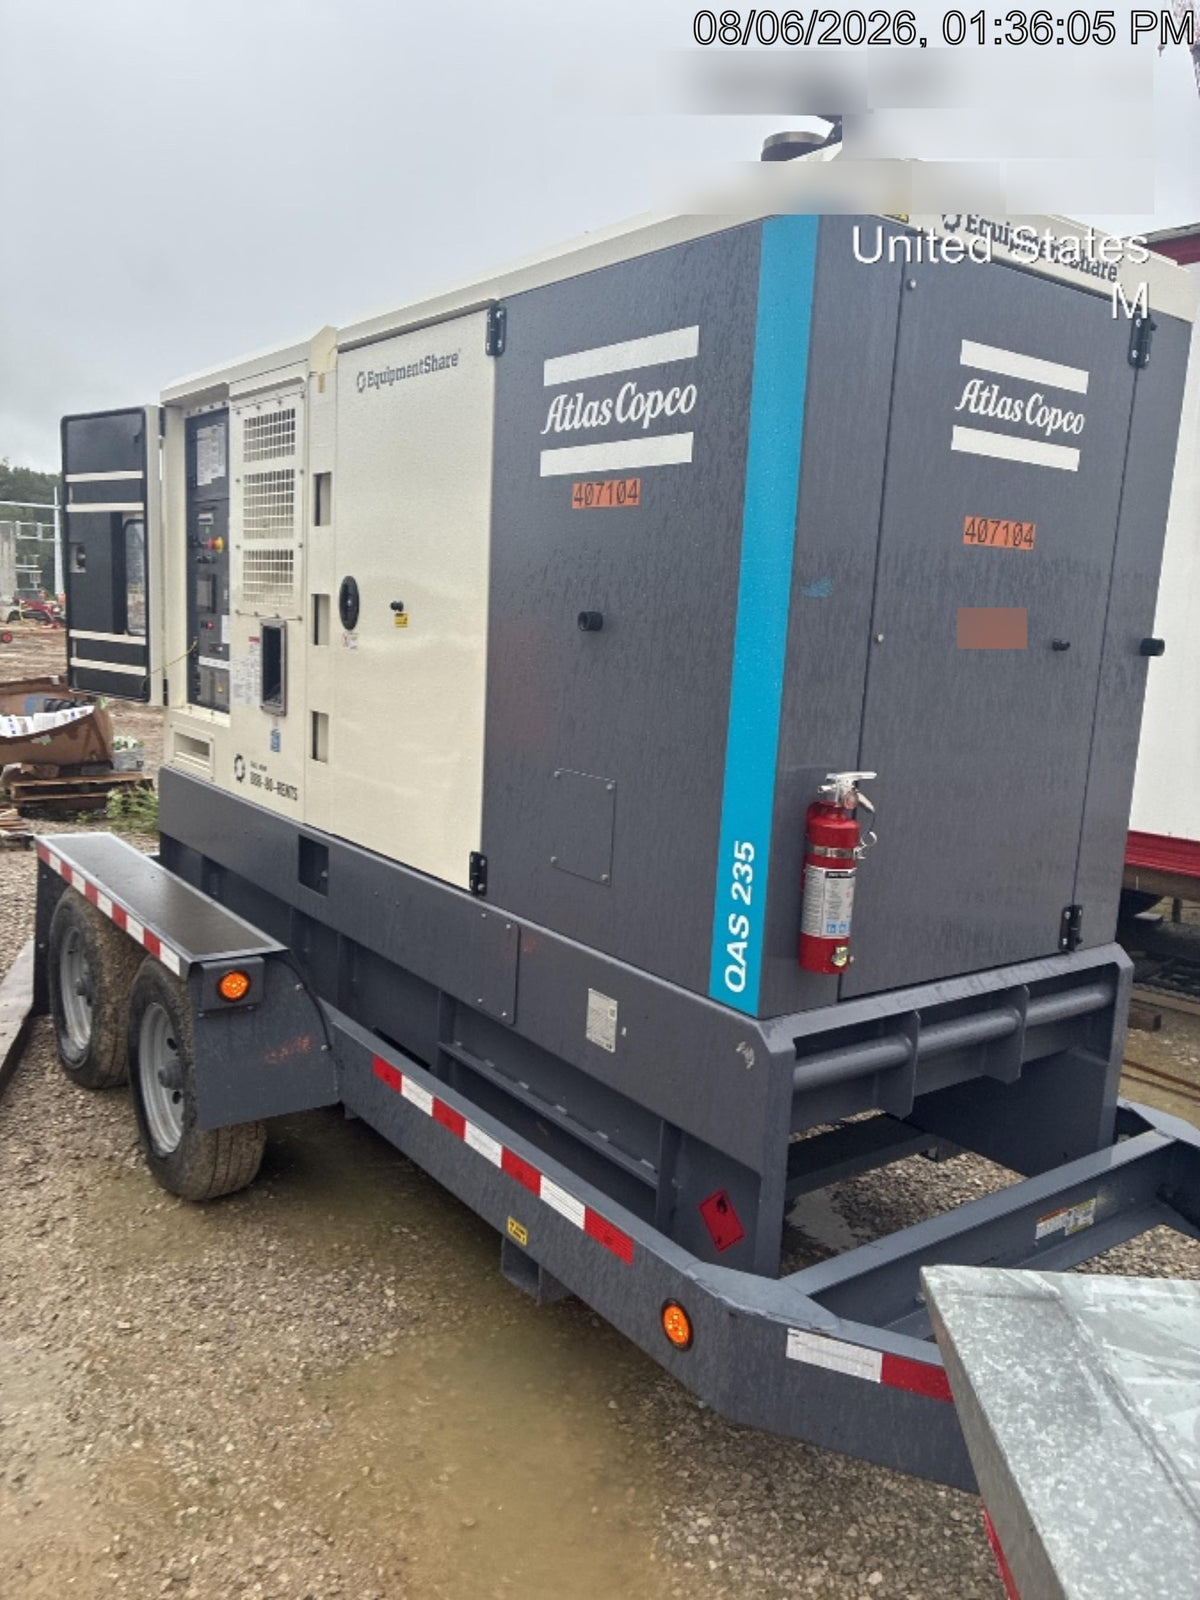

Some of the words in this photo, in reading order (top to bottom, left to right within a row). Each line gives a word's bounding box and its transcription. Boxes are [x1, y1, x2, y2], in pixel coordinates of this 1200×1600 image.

[367, 353, 459, 390] EquipmentShare
[540, 392, 613, 434] Atlas
[615, 382, 697, 429] Copco
[954, 378, 1024, 422] Atlas
[1025, 393, 1085, 436] Copco
[573, 479, 639, 507] 407104
[965, 518, 1035, 547] 407104
[731, 841, 755, 905] 235
[724, 913, 750, 993] QAS
